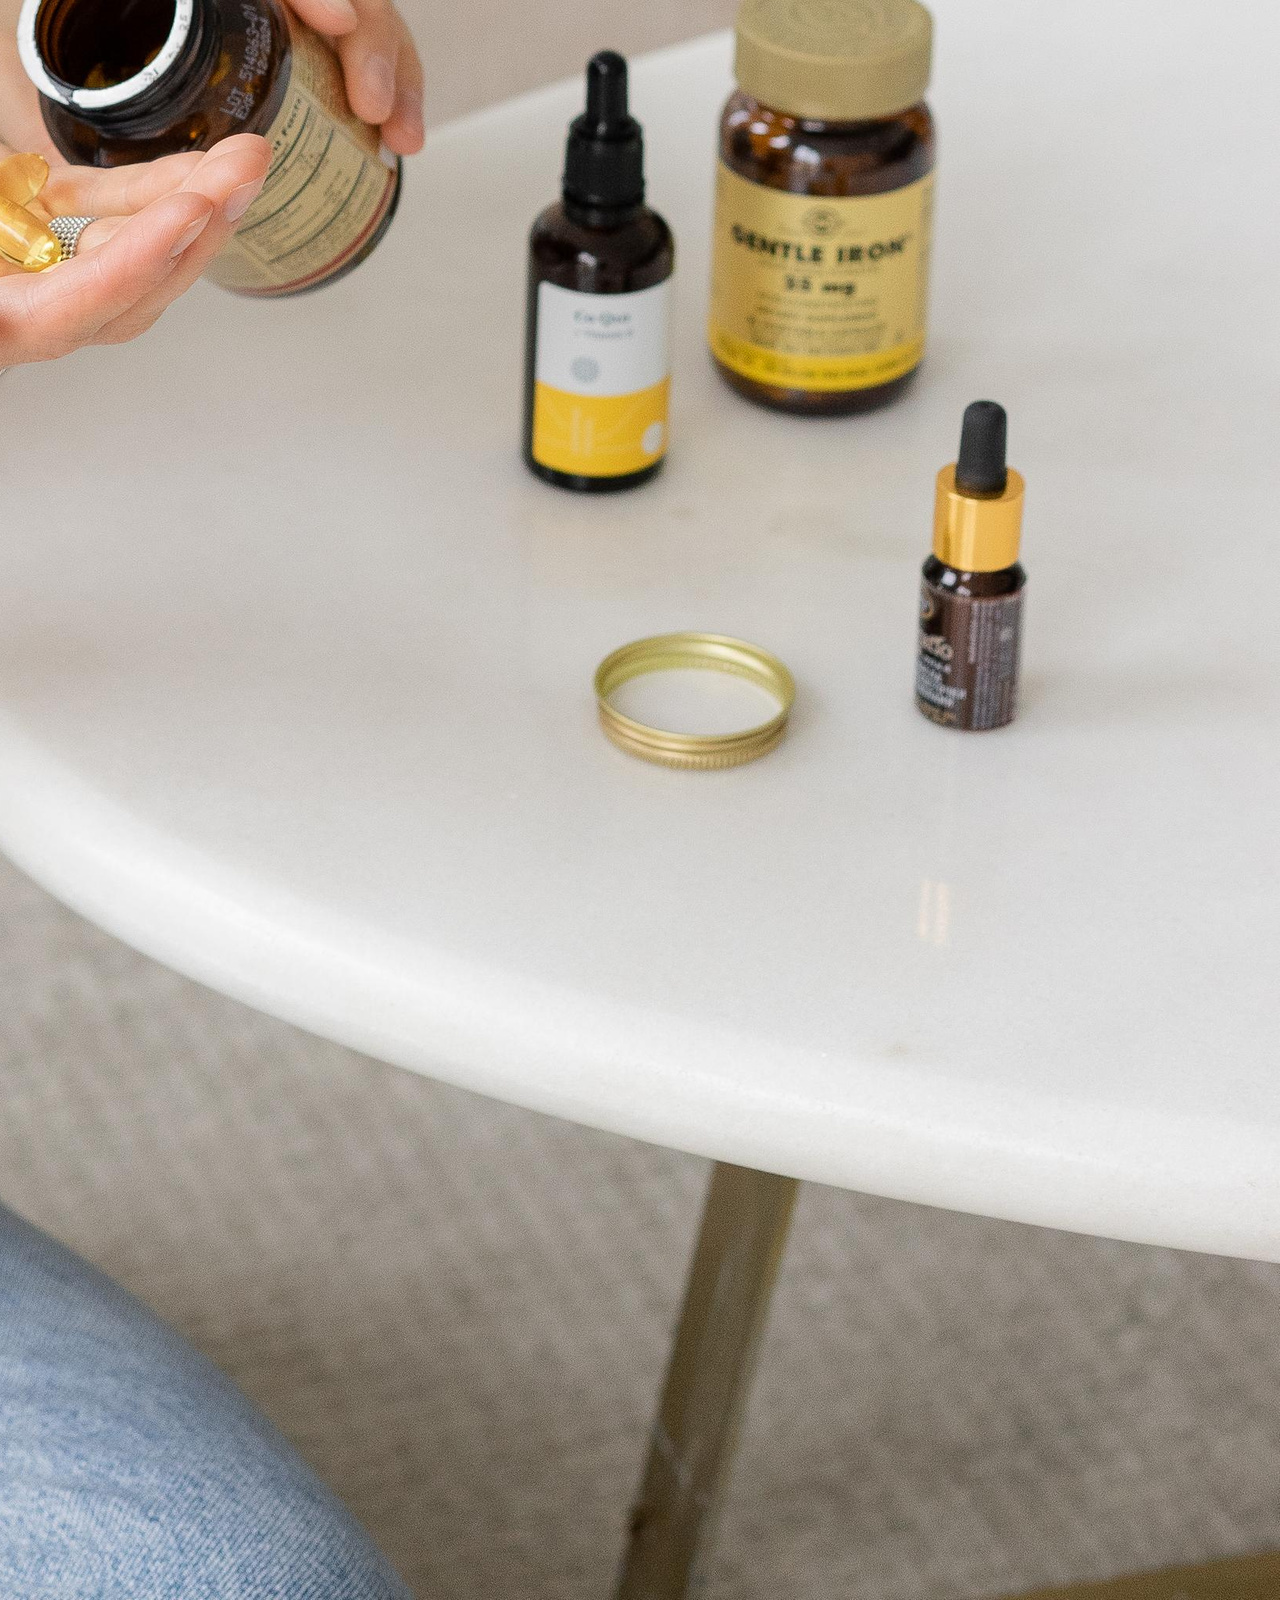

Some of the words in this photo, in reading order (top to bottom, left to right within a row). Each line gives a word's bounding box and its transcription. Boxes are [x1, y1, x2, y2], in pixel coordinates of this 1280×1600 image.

[219, 86, 242, 116] LOT
[732, 223, 823, 262] GENTLE
[837, 237, 905, 262] IRON
[822, 281, 855, 298] mg
